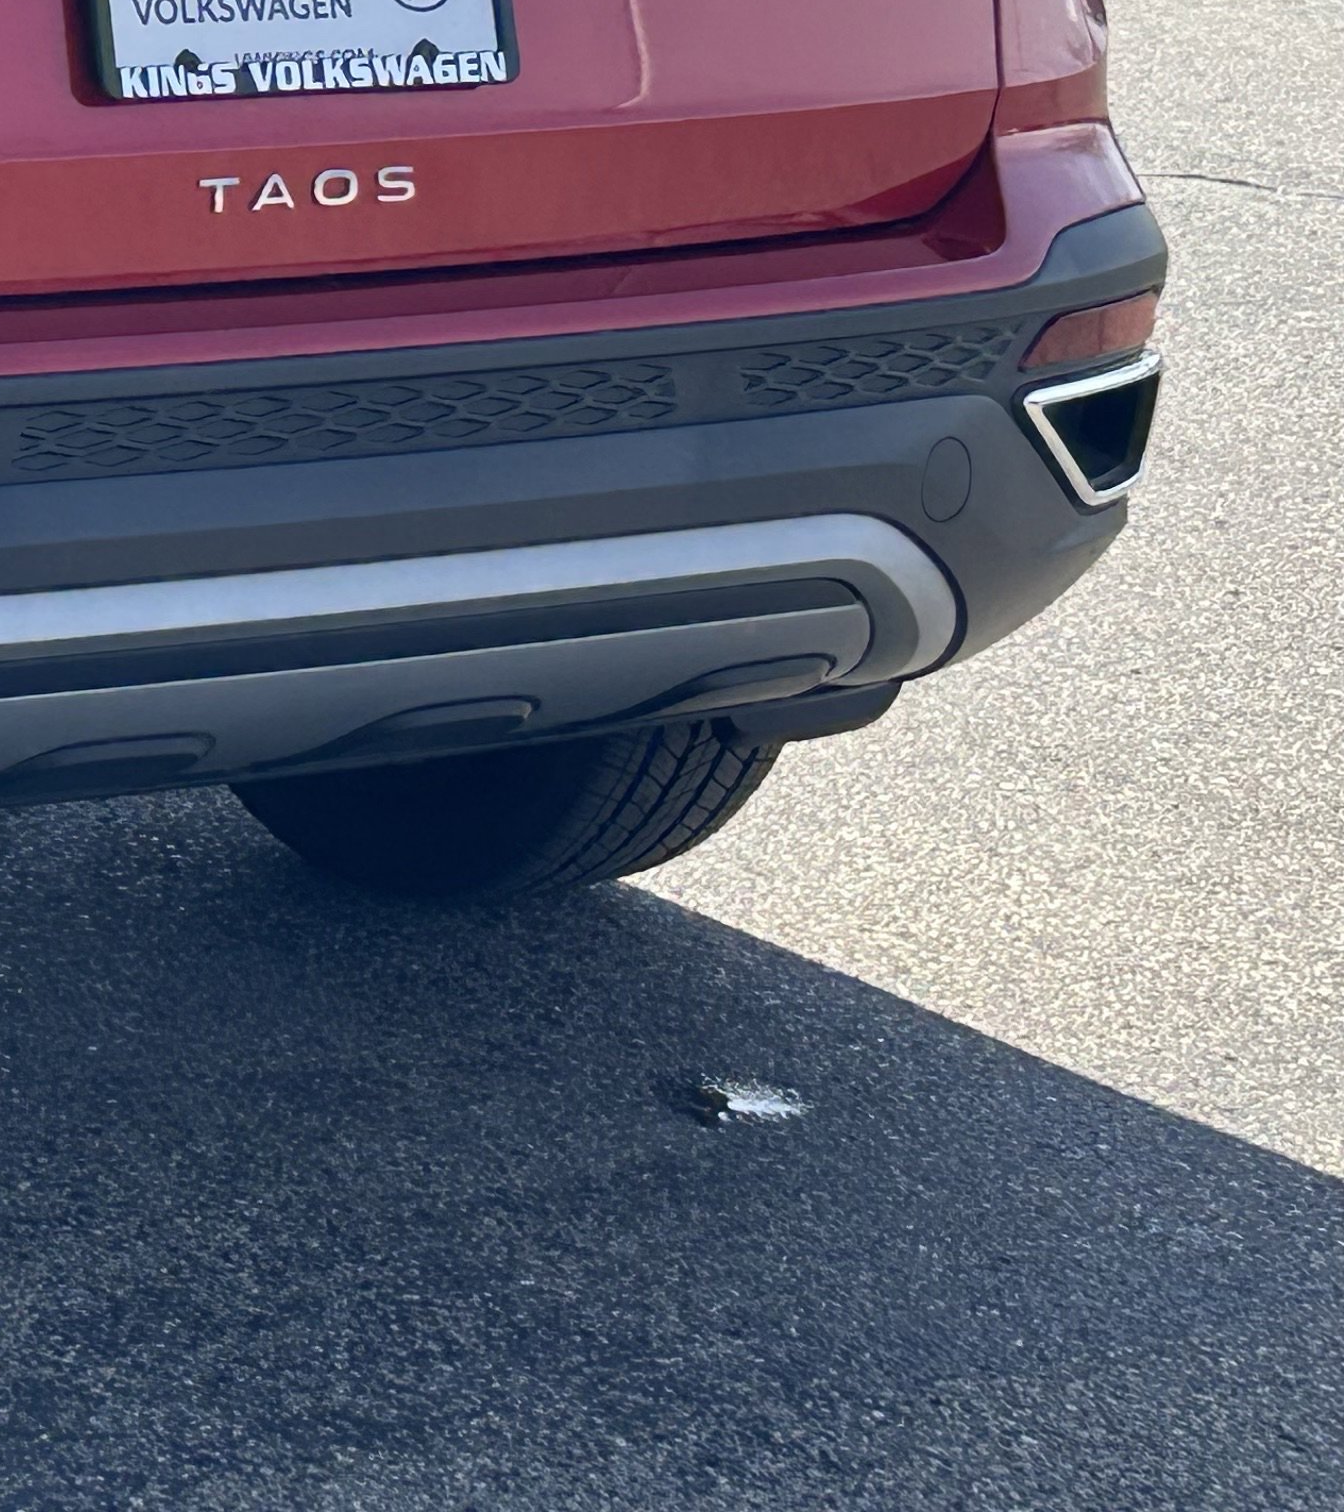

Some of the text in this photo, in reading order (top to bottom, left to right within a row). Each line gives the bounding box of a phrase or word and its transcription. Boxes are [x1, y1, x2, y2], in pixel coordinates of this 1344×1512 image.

[120, 61, 239, 99] KINGS
[247, 50, 507, 93] VOLKSWAGEN
[198, 165, 416, 214] TAOS
